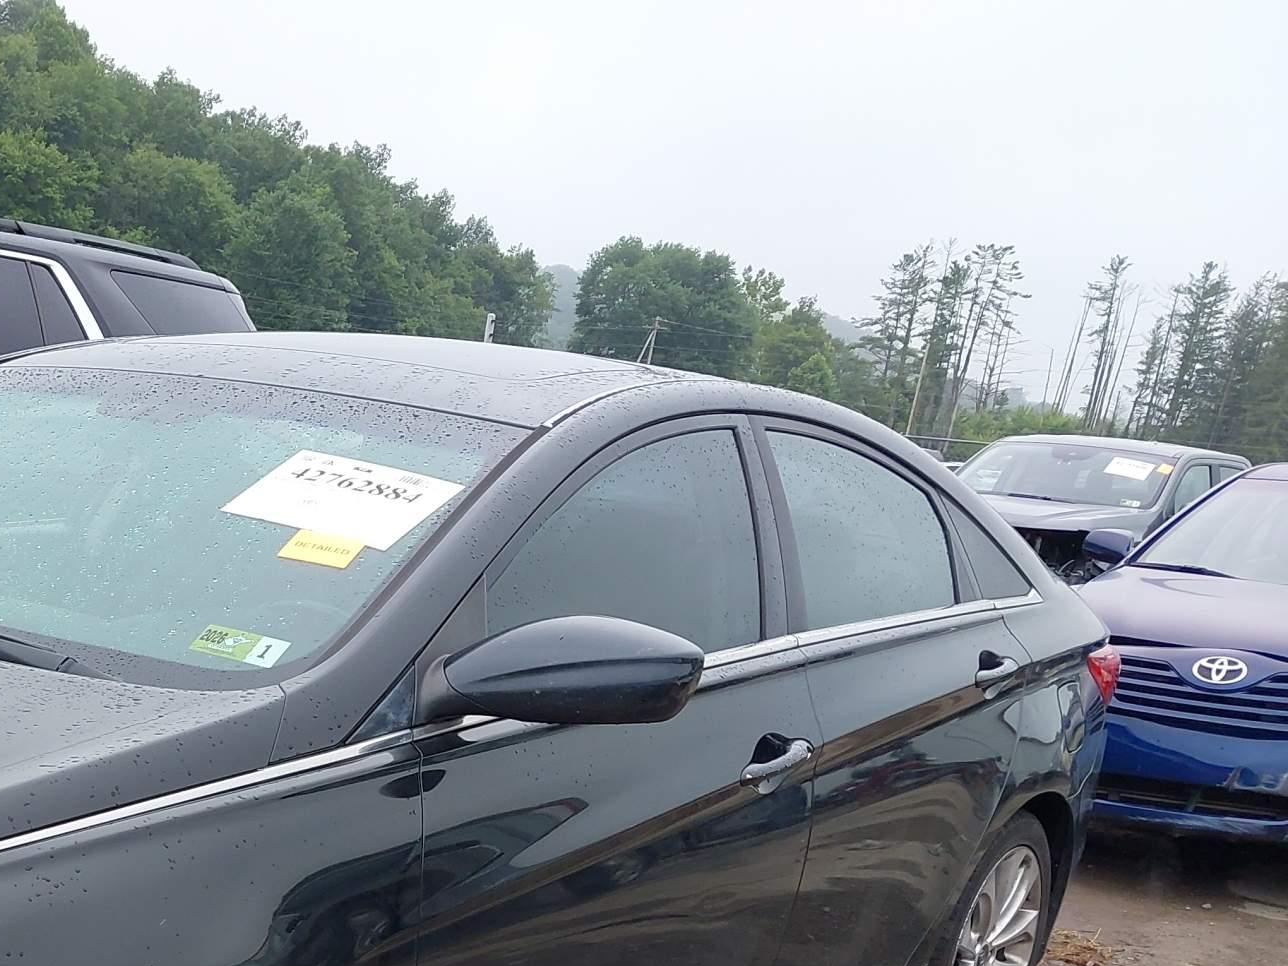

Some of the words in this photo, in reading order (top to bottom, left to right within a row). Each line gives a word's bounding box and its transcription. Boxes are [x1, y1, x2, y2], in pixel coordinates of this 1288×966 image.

[291, 467, 423, 503] 42762884
[294, 540, 351, 556] DETAILED
[199, 628, 229, 645] 2026
[256, 644, 273, 659] 1
